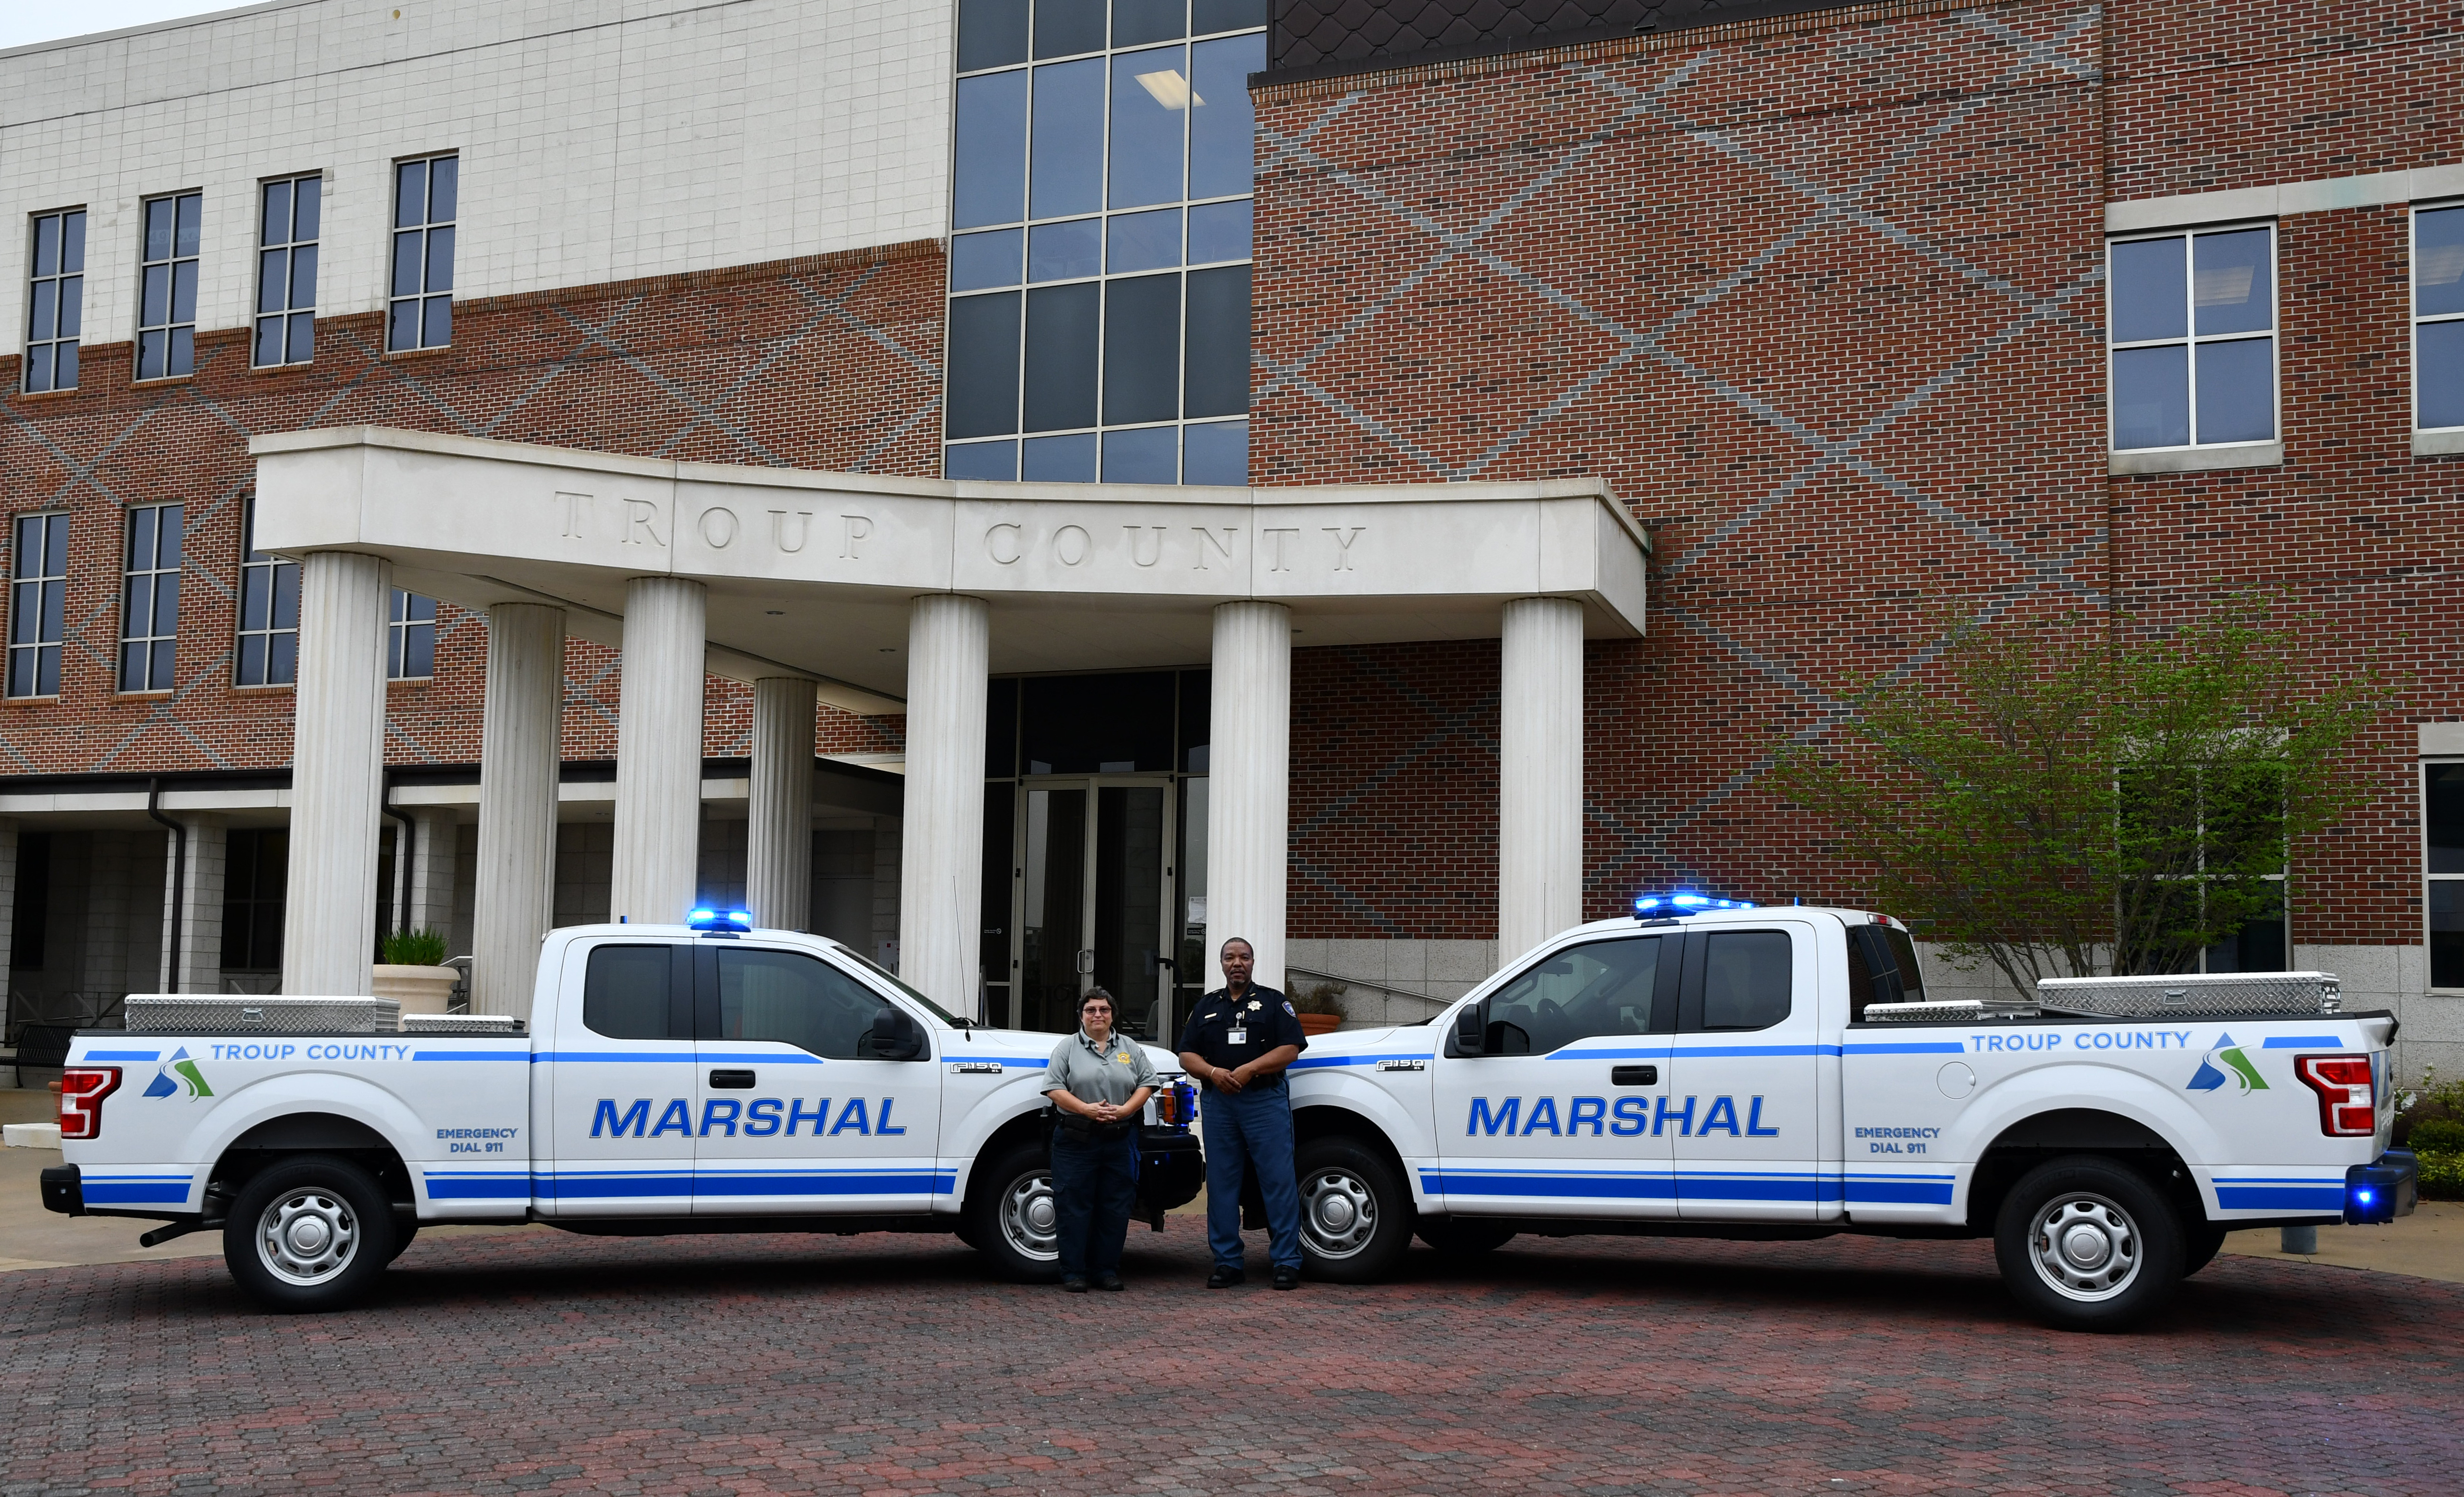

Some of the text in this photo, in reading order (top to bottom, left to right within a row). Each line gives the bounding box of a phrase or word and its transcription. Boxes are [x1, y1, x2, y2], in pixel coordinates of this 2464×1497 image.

[554, 491, 1367, 572] TROUP COUNTY
[1970, 1031, 2193, 1052] TROUP COUNTY
[211, 1044, 411, 1060] TROUP COUNTY
[589, 1097, 907, 1138] MARSHAL
[1466, 1095, 1780, 1138] MARSHAL
[436, 1128, 519, 1139] EMERGENCY
[1855, 1127, 1941, 1138] EMERGENCY
[450, 1142, 503, 1153] DIAL 911
[1869, 1142, 1926, 1154] DIAL 911
